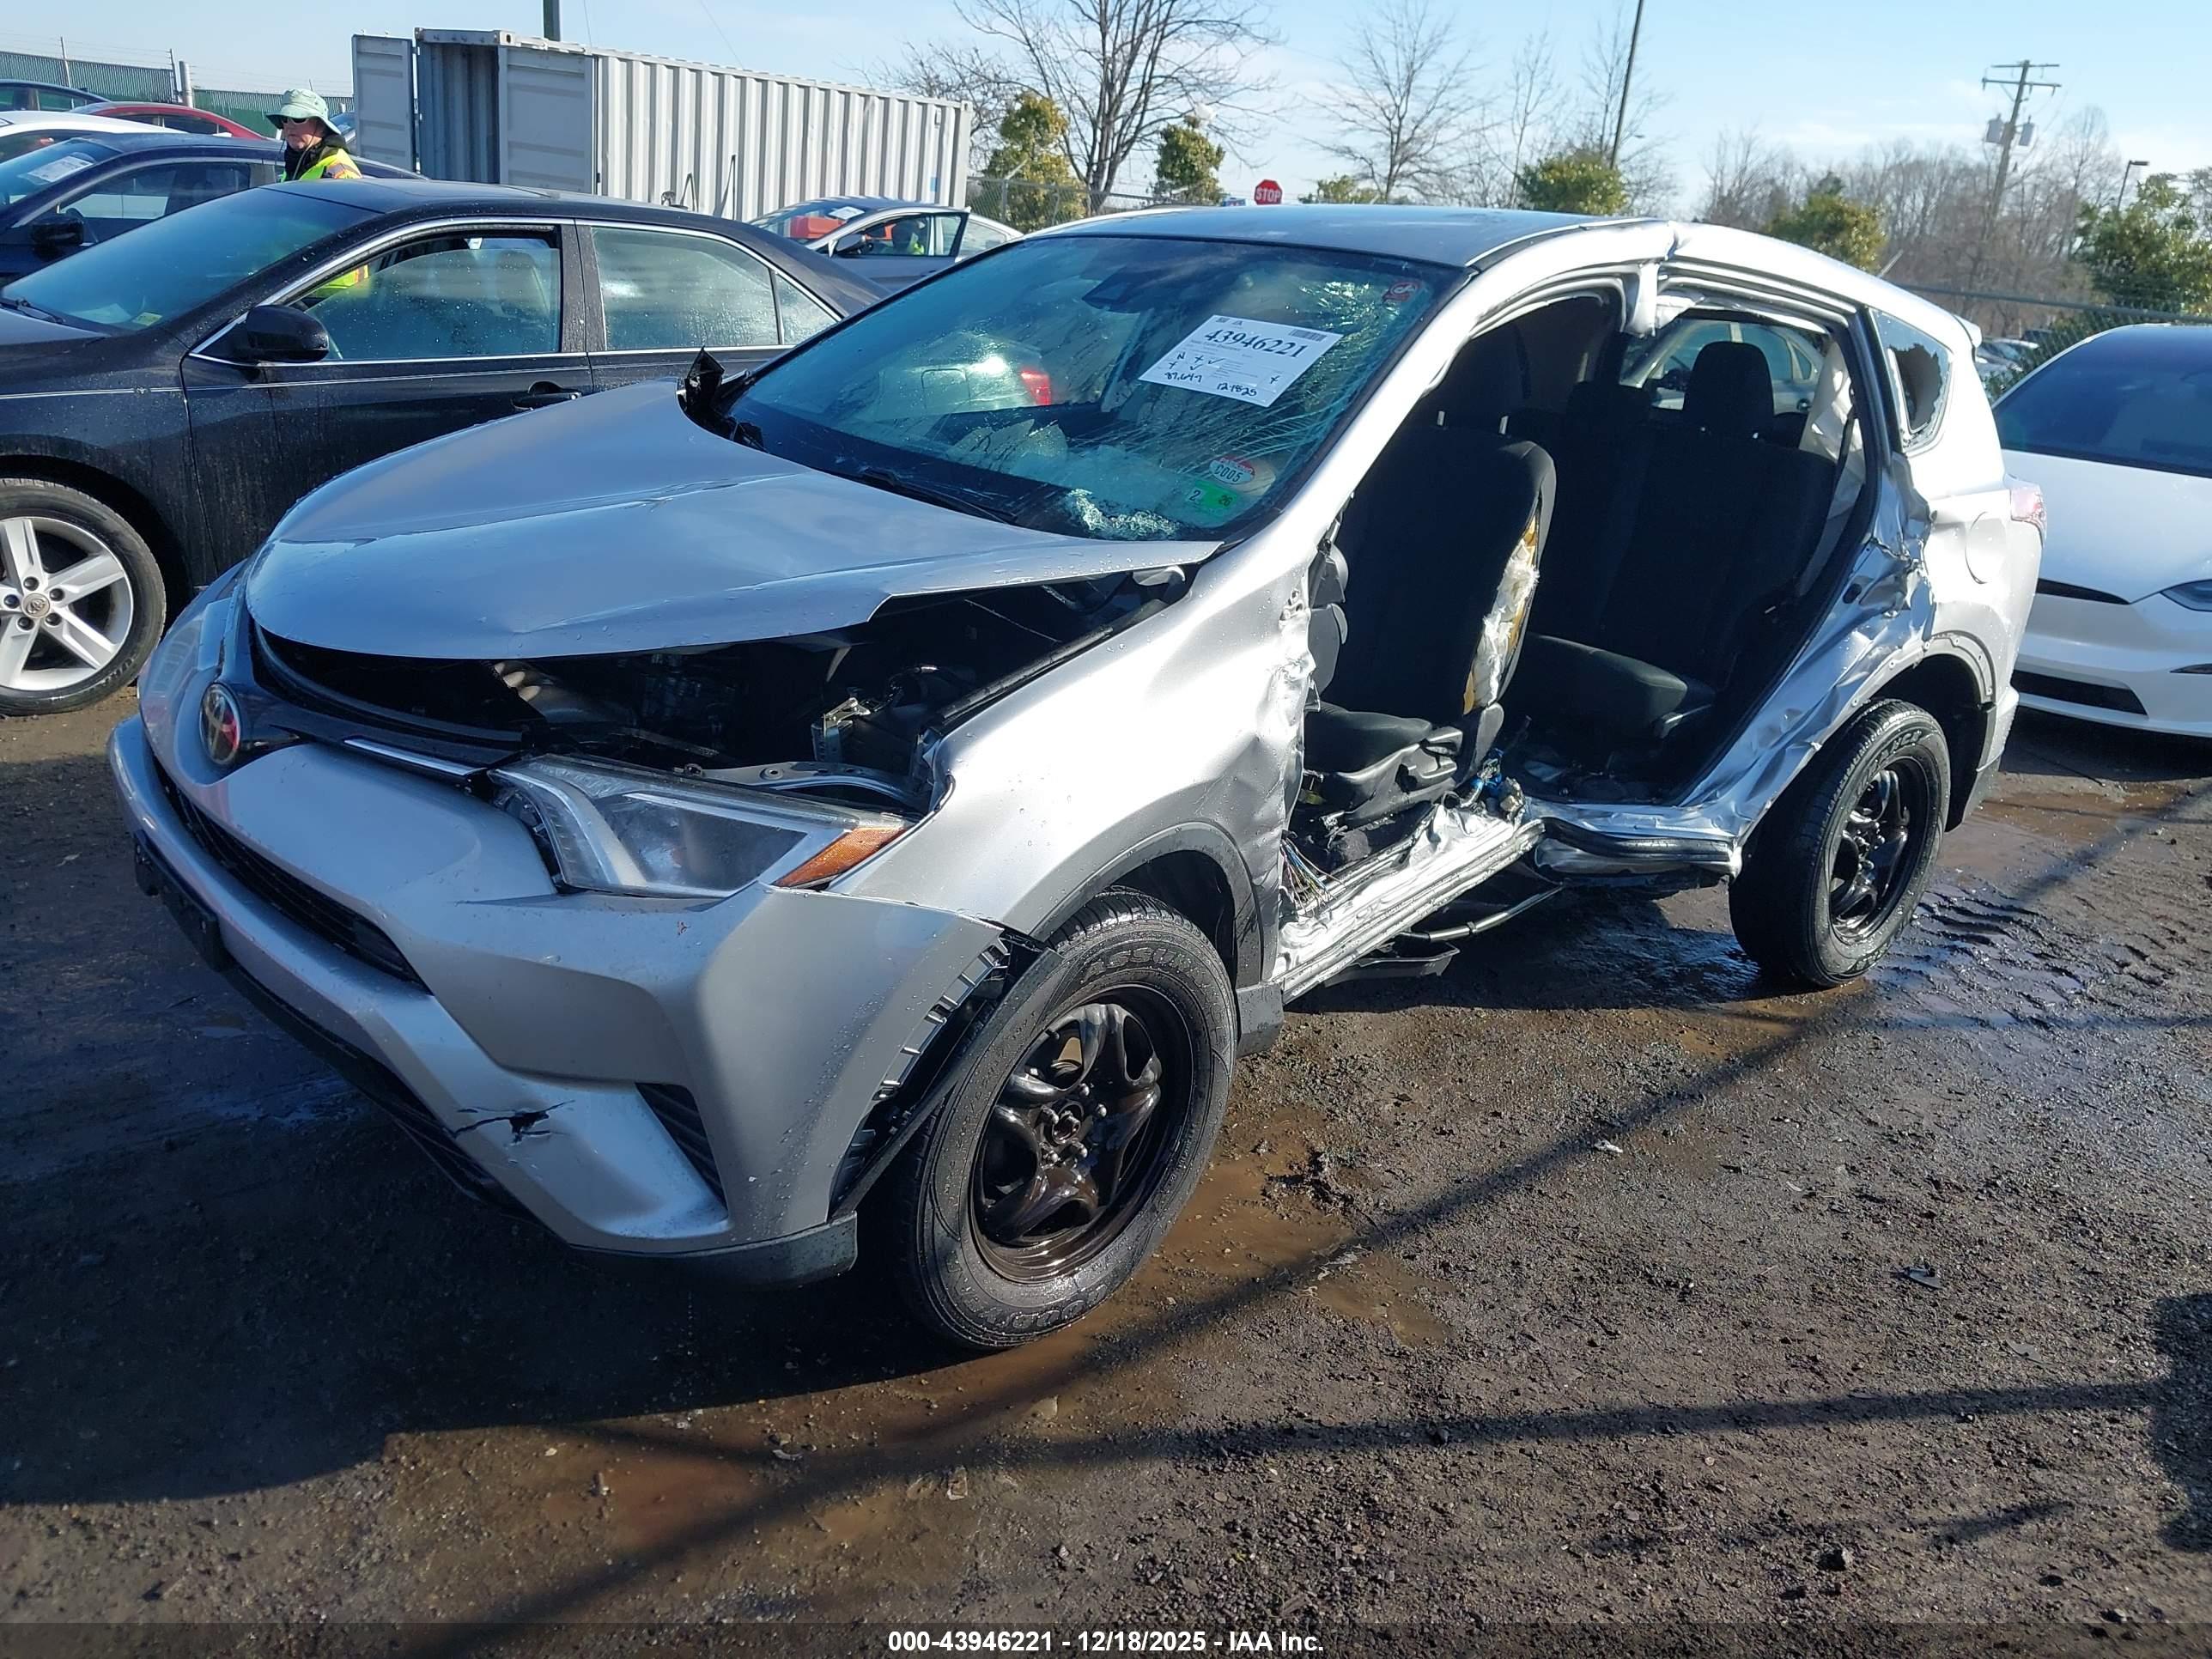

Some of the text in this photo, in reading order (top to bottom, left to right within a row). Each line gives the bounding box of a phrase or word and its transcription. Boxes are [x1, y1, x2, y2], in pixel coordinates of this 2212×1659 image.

[1256, 186, 1281, 203] STOP
[1205, 328, 1308, 358] 43946221
[1188, 489, 1201, 501] 2
